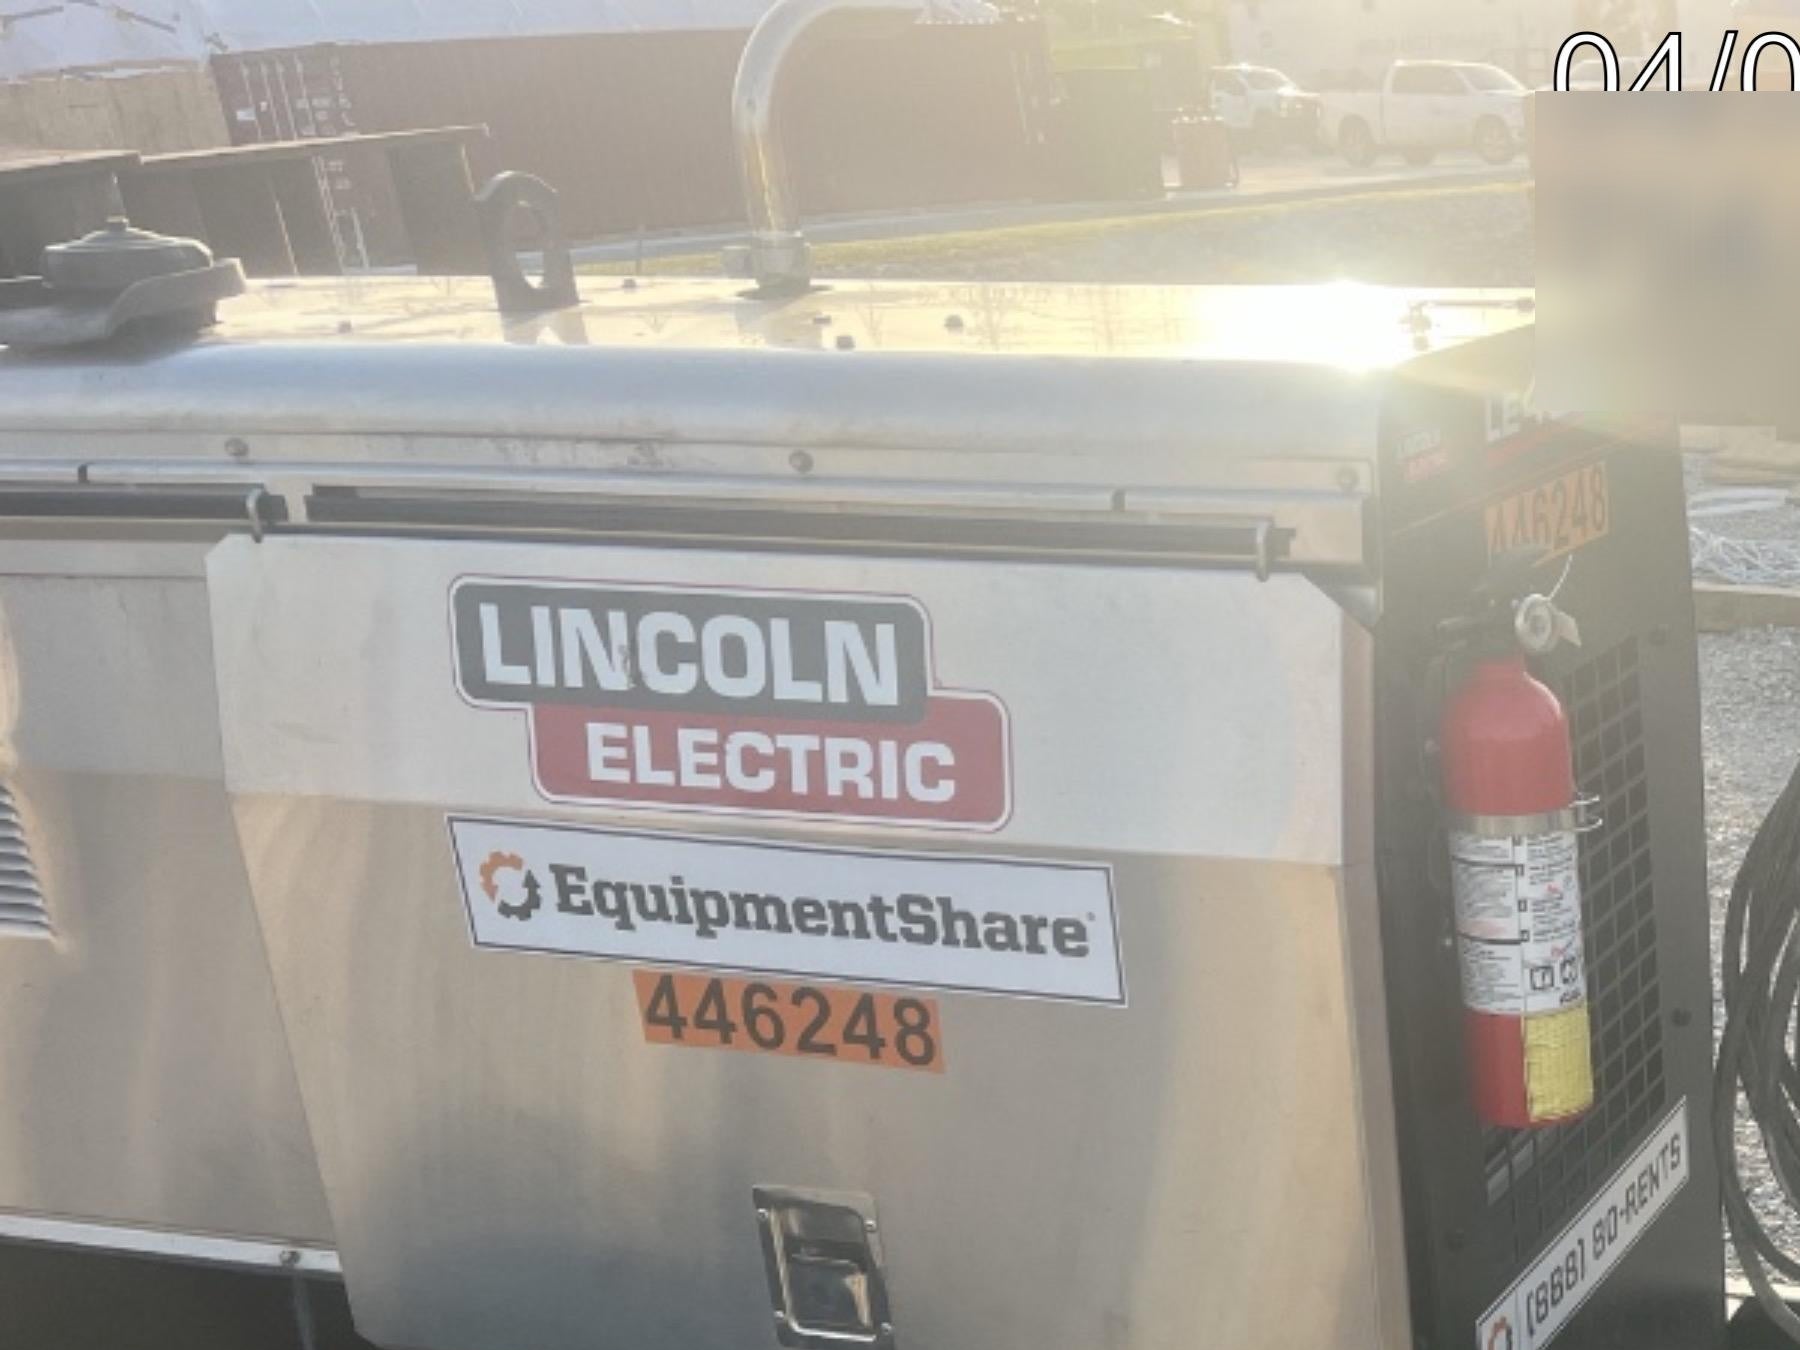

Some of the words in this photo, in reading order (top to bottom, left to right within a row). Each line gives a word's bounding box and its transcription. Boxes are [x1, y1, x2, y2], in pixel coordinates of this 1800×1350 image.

[478, 602, 900, 706] LINCOLN
[585, 721, 956, 803] ELECTRIC
[549, 861, 1092, 959] EquipmentShare
[645, 974, 938, 1067] 446248
[1592, 1132, 1682, 1261] 80-RENTS
